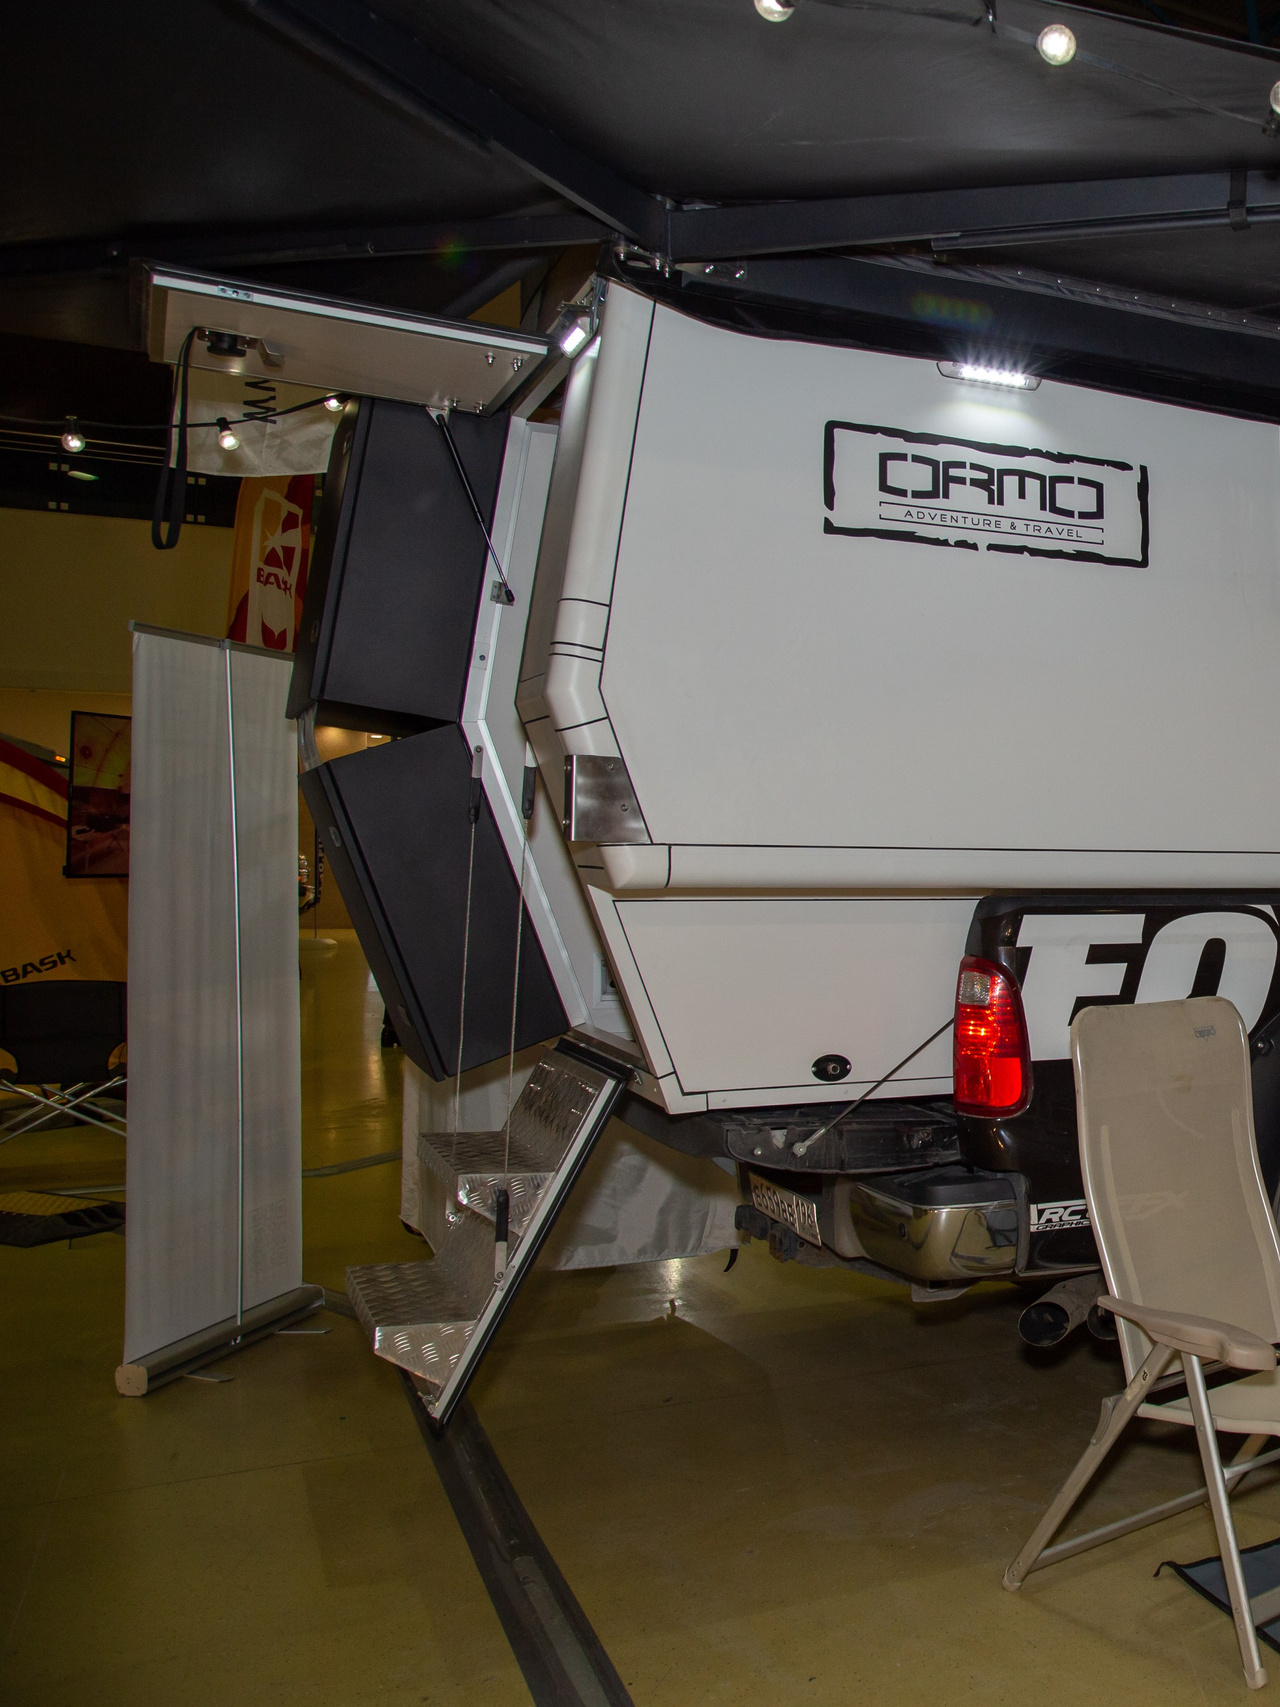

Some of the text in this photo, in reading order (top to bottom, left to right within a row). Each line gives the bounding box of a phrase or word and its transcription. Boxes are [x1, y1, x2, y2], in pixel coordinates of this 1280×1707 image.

[903, 509, 1083, 538] ADVENTURE & TRAVEL
[0, 949, 77, 984] BASK
